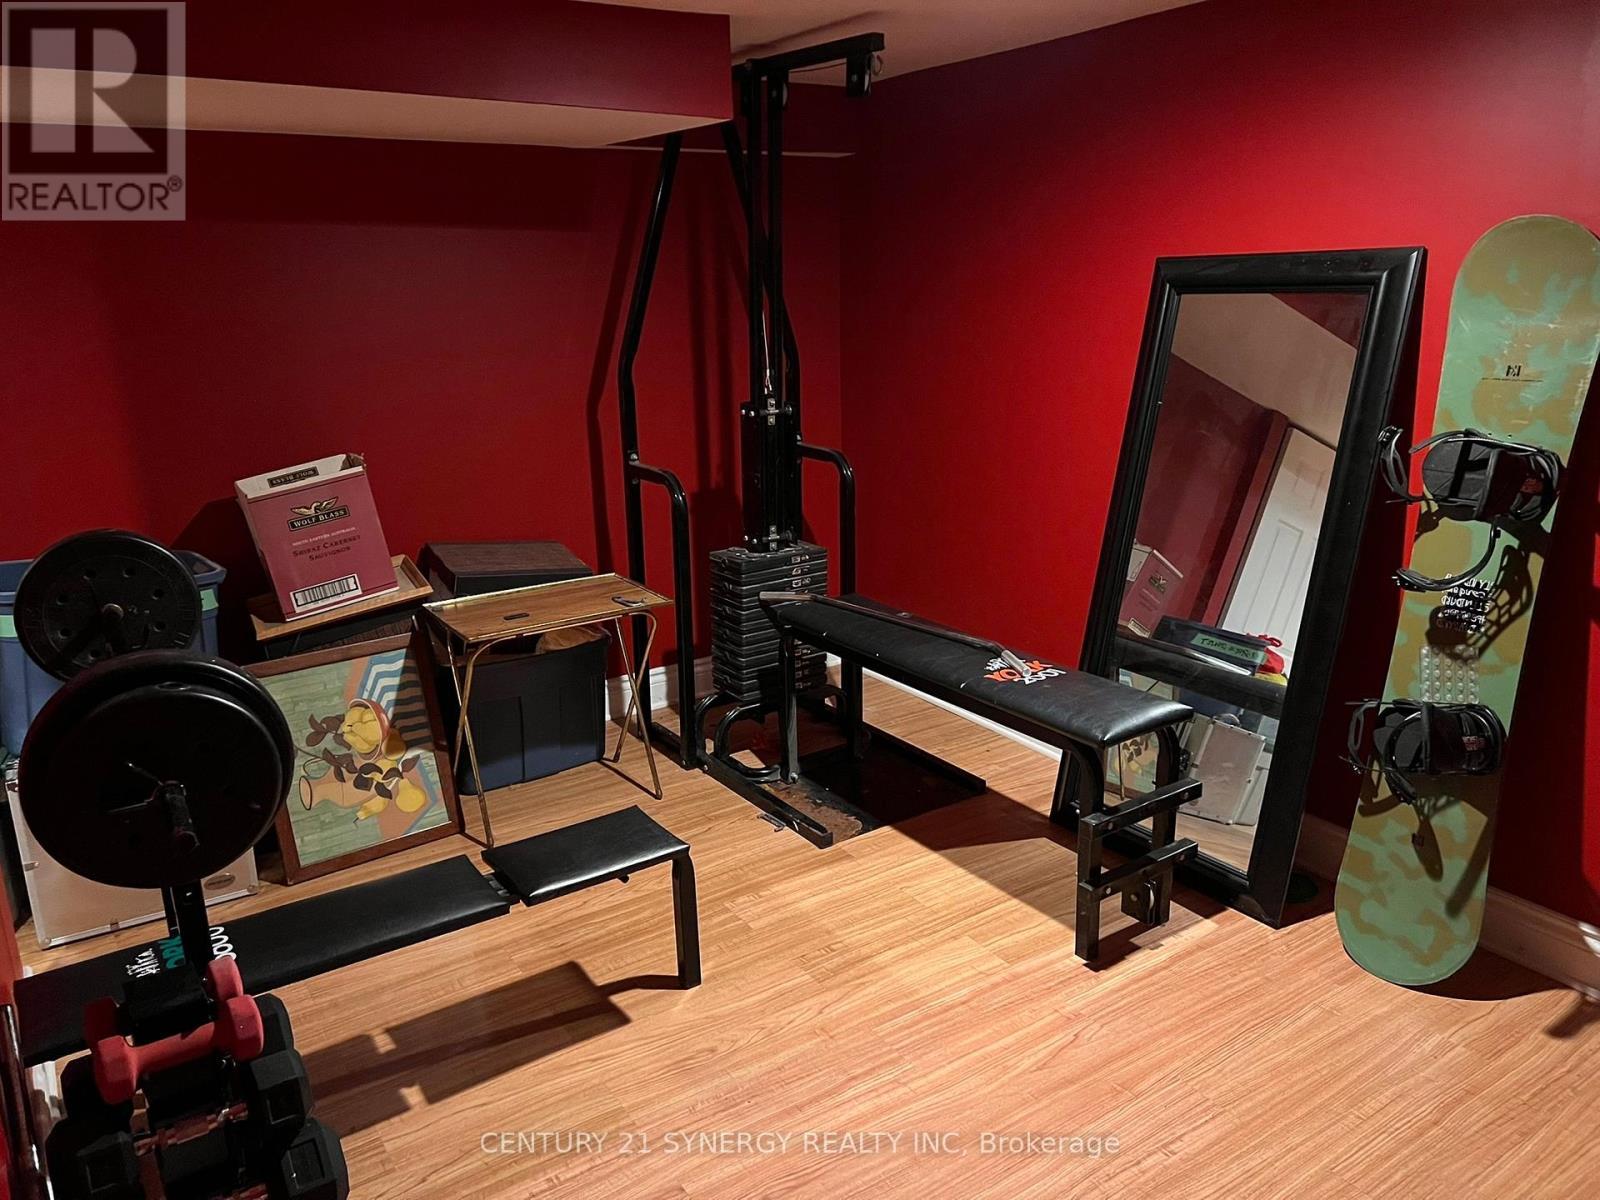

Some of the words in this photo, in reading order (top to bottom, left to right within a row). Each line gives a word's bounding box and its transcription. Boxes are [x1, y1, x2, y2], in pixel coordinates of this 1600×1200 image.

[293, 517, 316, 528] WOLF
[318, 509, 346, 521] BLASS
[984, 661, 1053, 681] YOK
